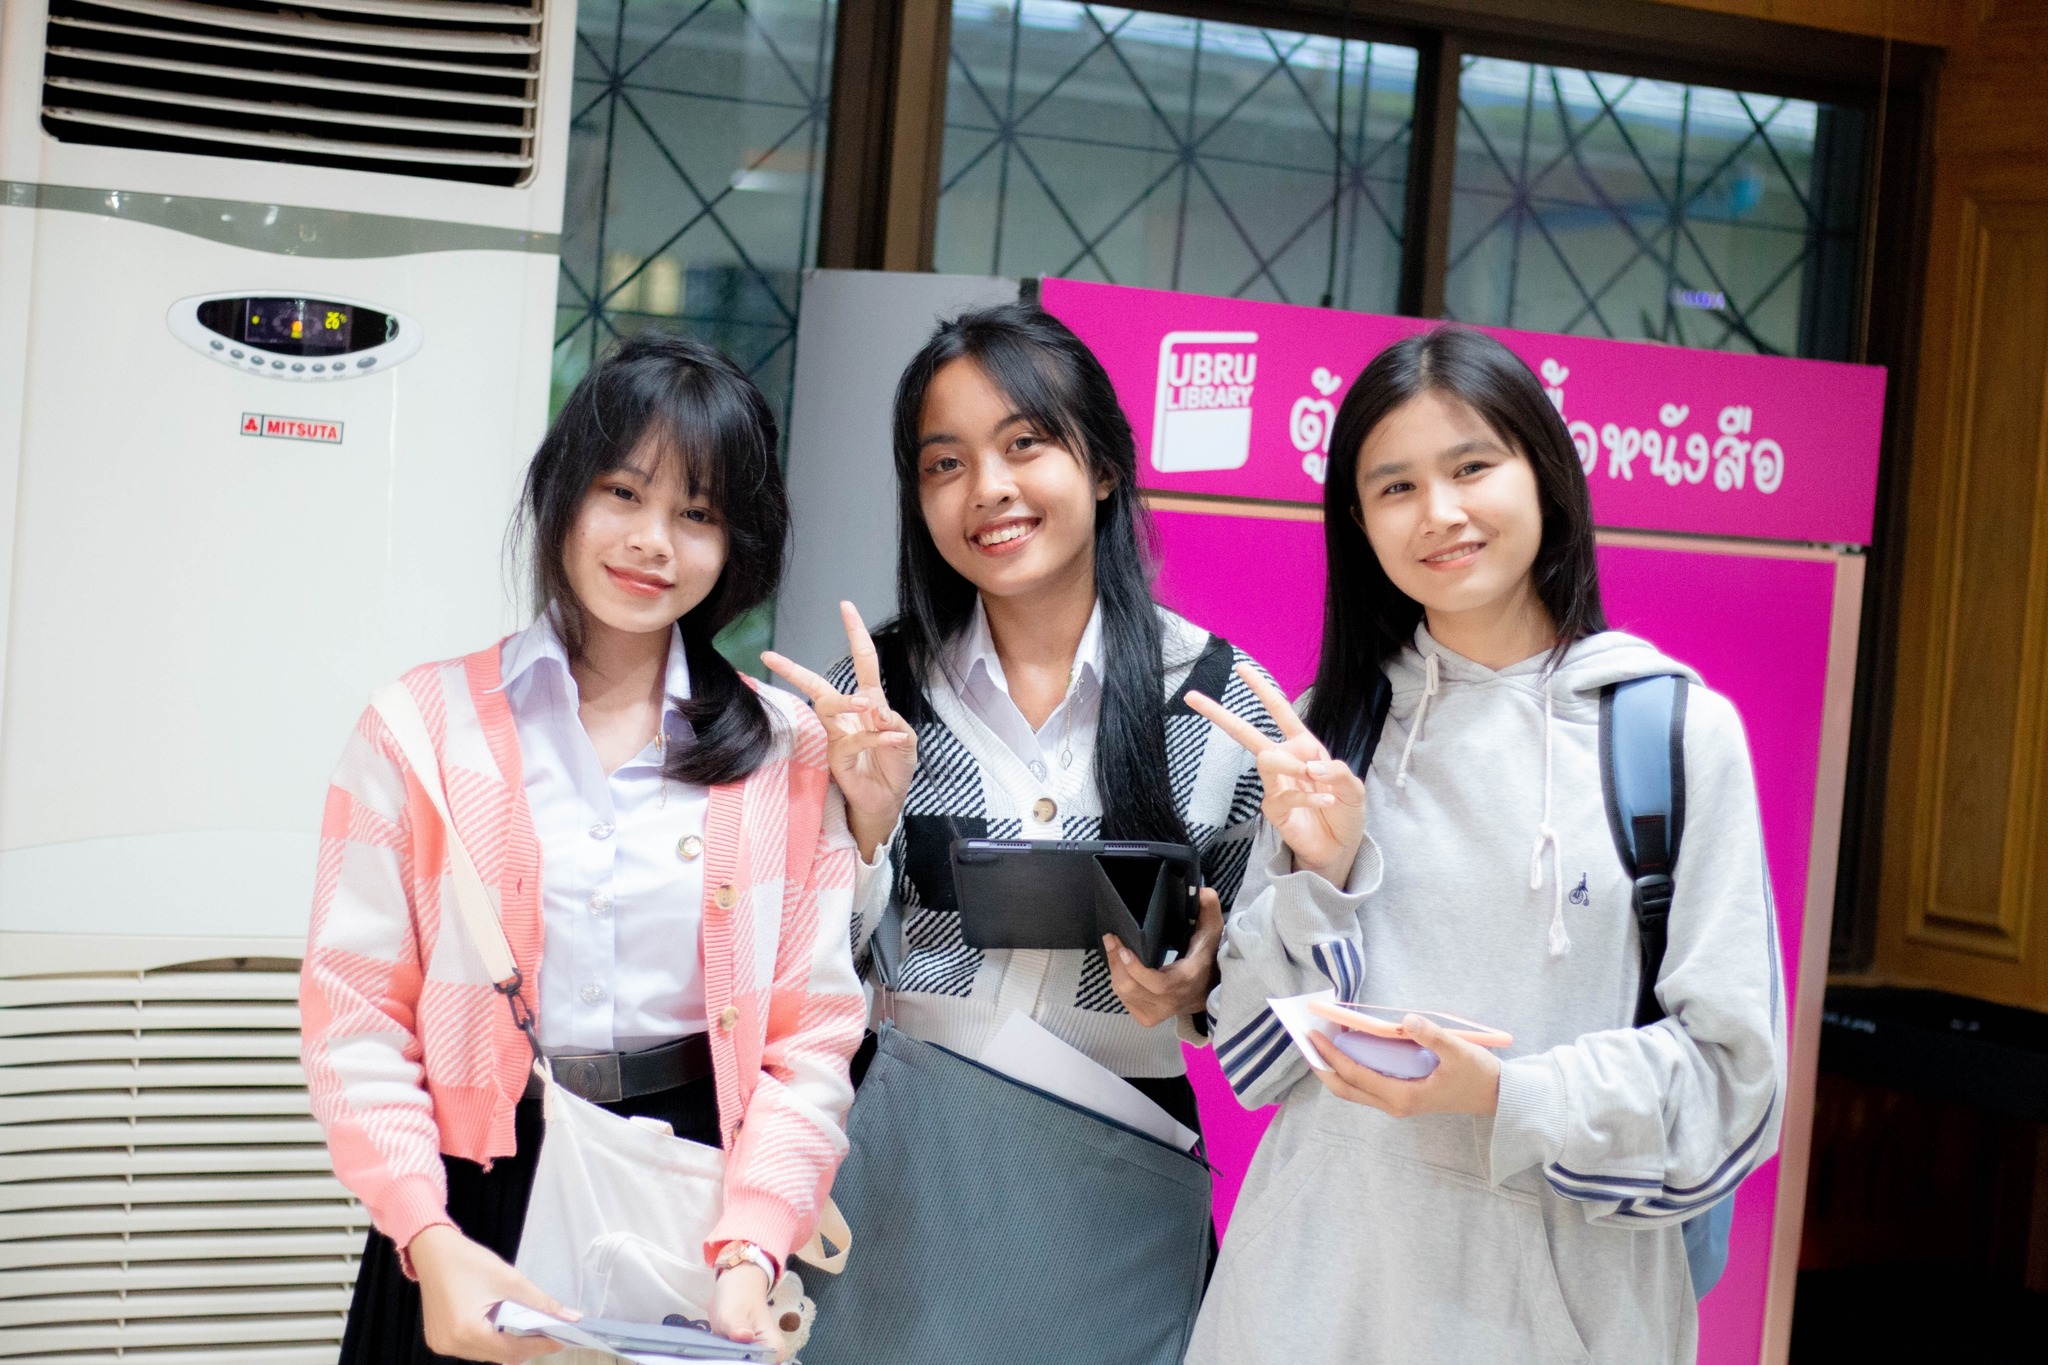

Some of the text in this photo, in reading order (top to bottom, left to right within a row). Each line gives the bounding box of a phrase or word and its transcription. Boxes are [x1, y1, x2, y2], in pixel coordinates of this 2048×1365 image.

[1168, 352, 1257, 387] UBRU
[1166, 385, 1254, 410] LIBRARY
[266, 420, 338, 440] MITSUTA
